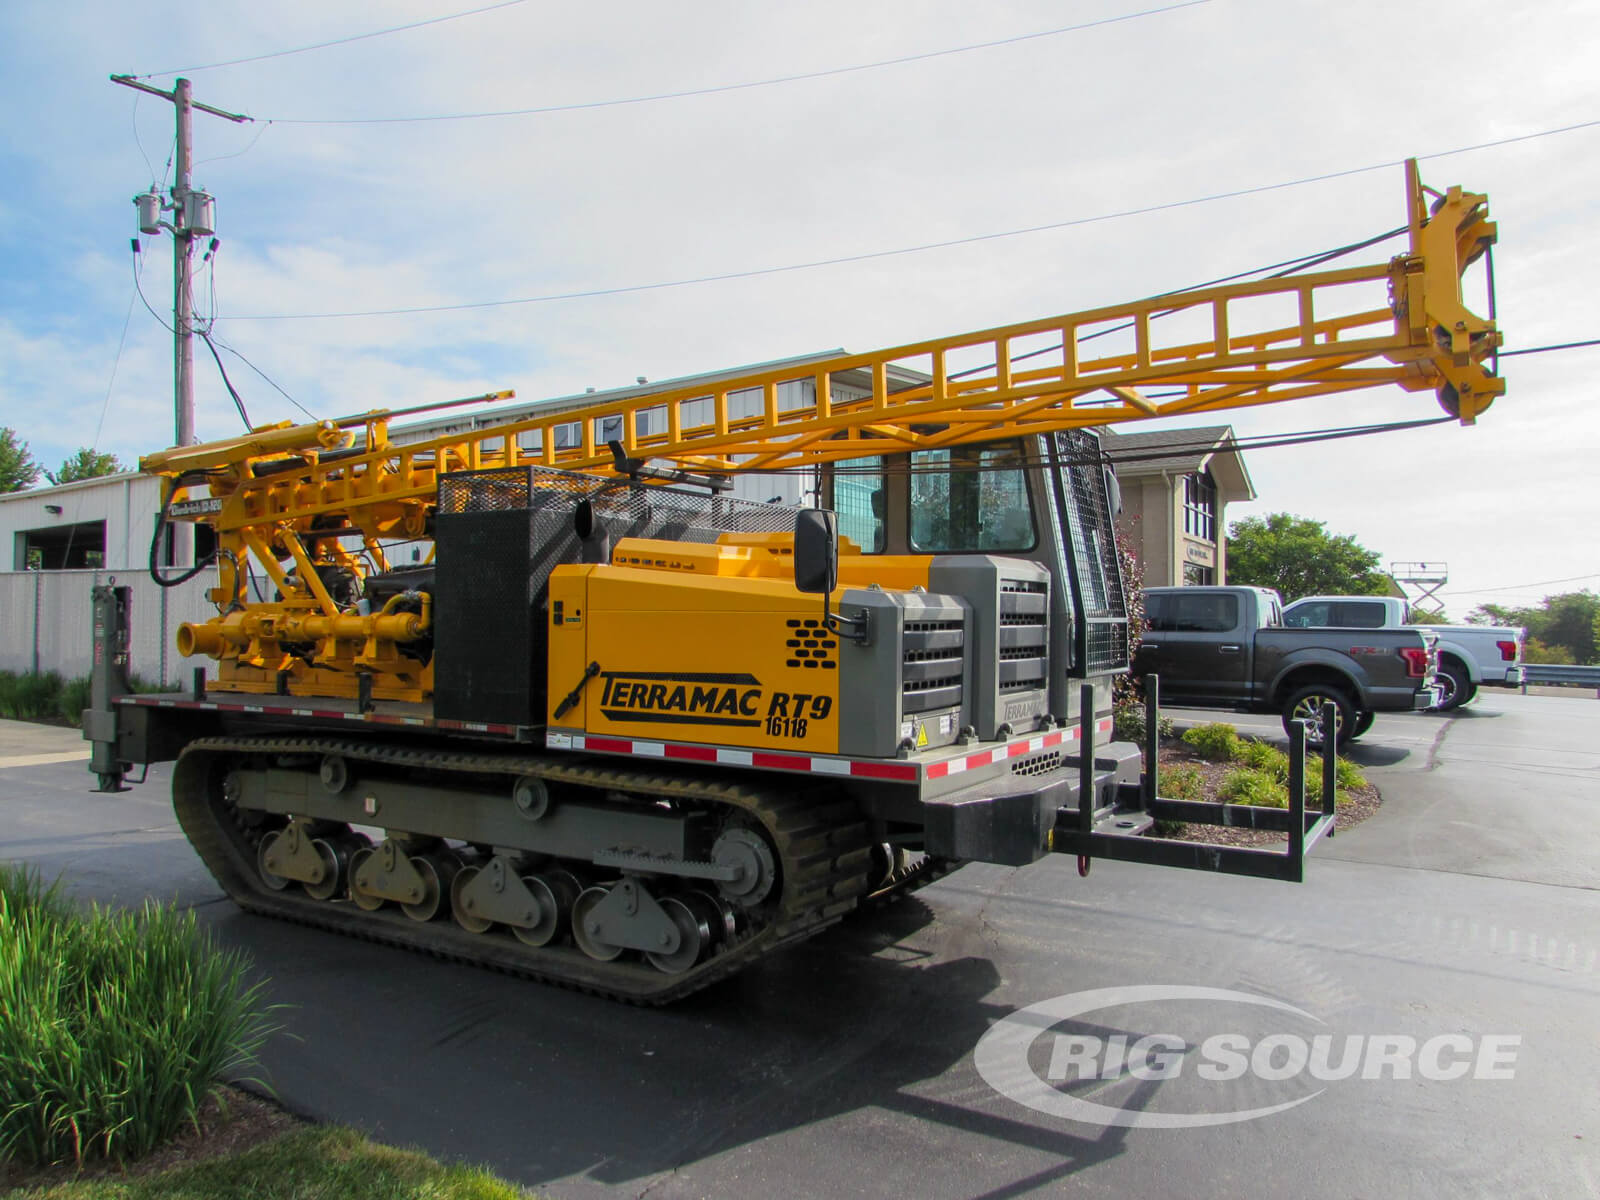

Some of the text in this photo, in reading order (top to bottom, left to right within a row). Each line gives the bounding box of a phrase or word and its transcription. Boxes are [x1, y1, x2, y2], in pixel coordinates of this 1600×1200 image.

[600, 671, 833, 720] TERRAMAC RT9
[765, 716, 808, 738] 16118
